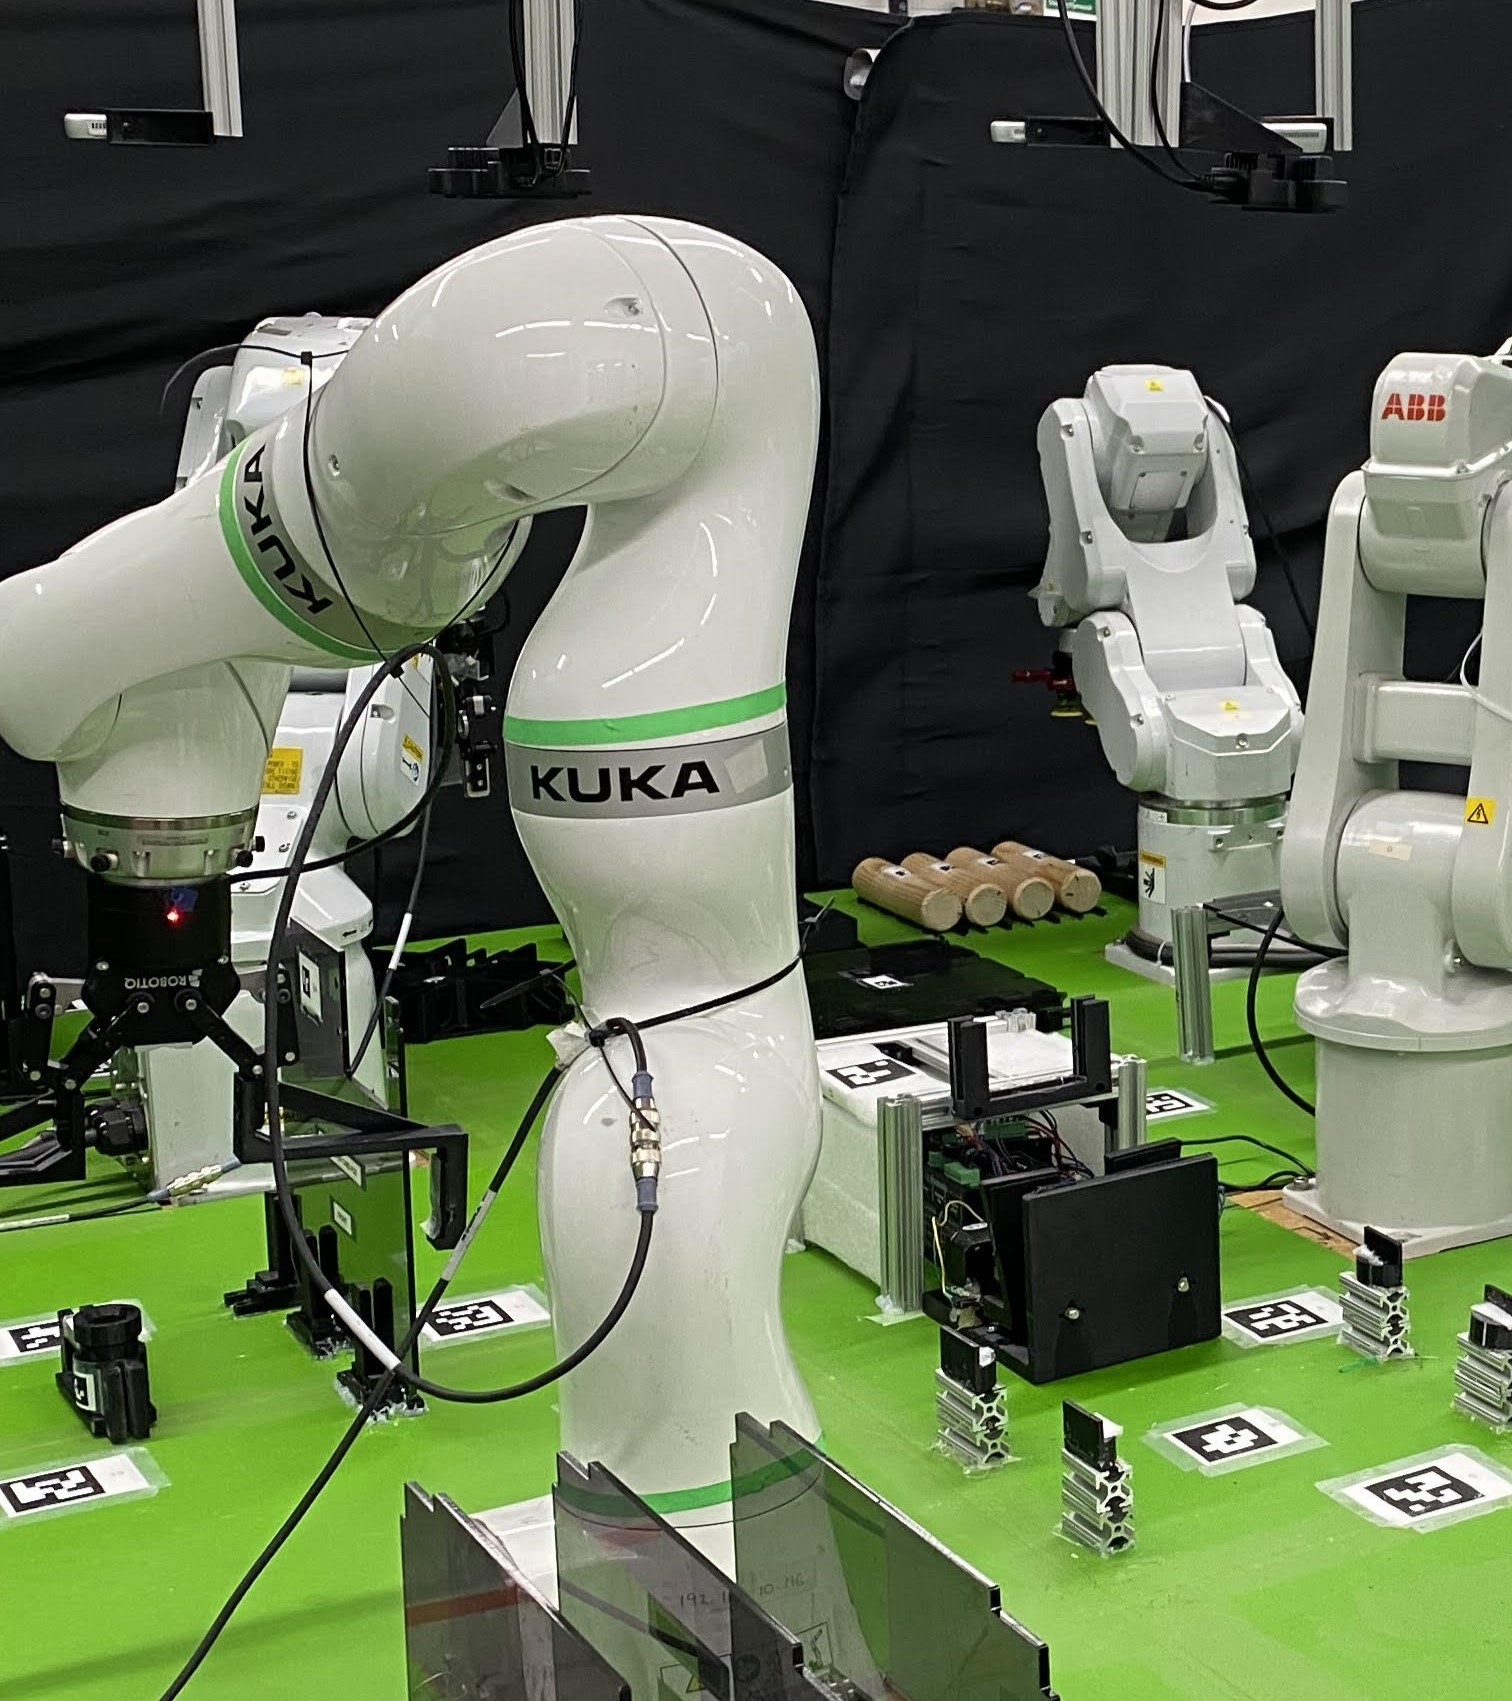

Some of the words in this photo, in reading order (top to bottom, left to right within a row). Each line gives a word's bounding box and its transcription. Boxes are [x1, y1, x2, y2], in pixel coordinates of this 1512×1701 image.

[1381, 393, 1446, 421] ABB
[243, 442, 334, 615] KUKA
[530, 760, 721, 803] KUKA
[124, 974, 187, 990] ROBOTIQ
